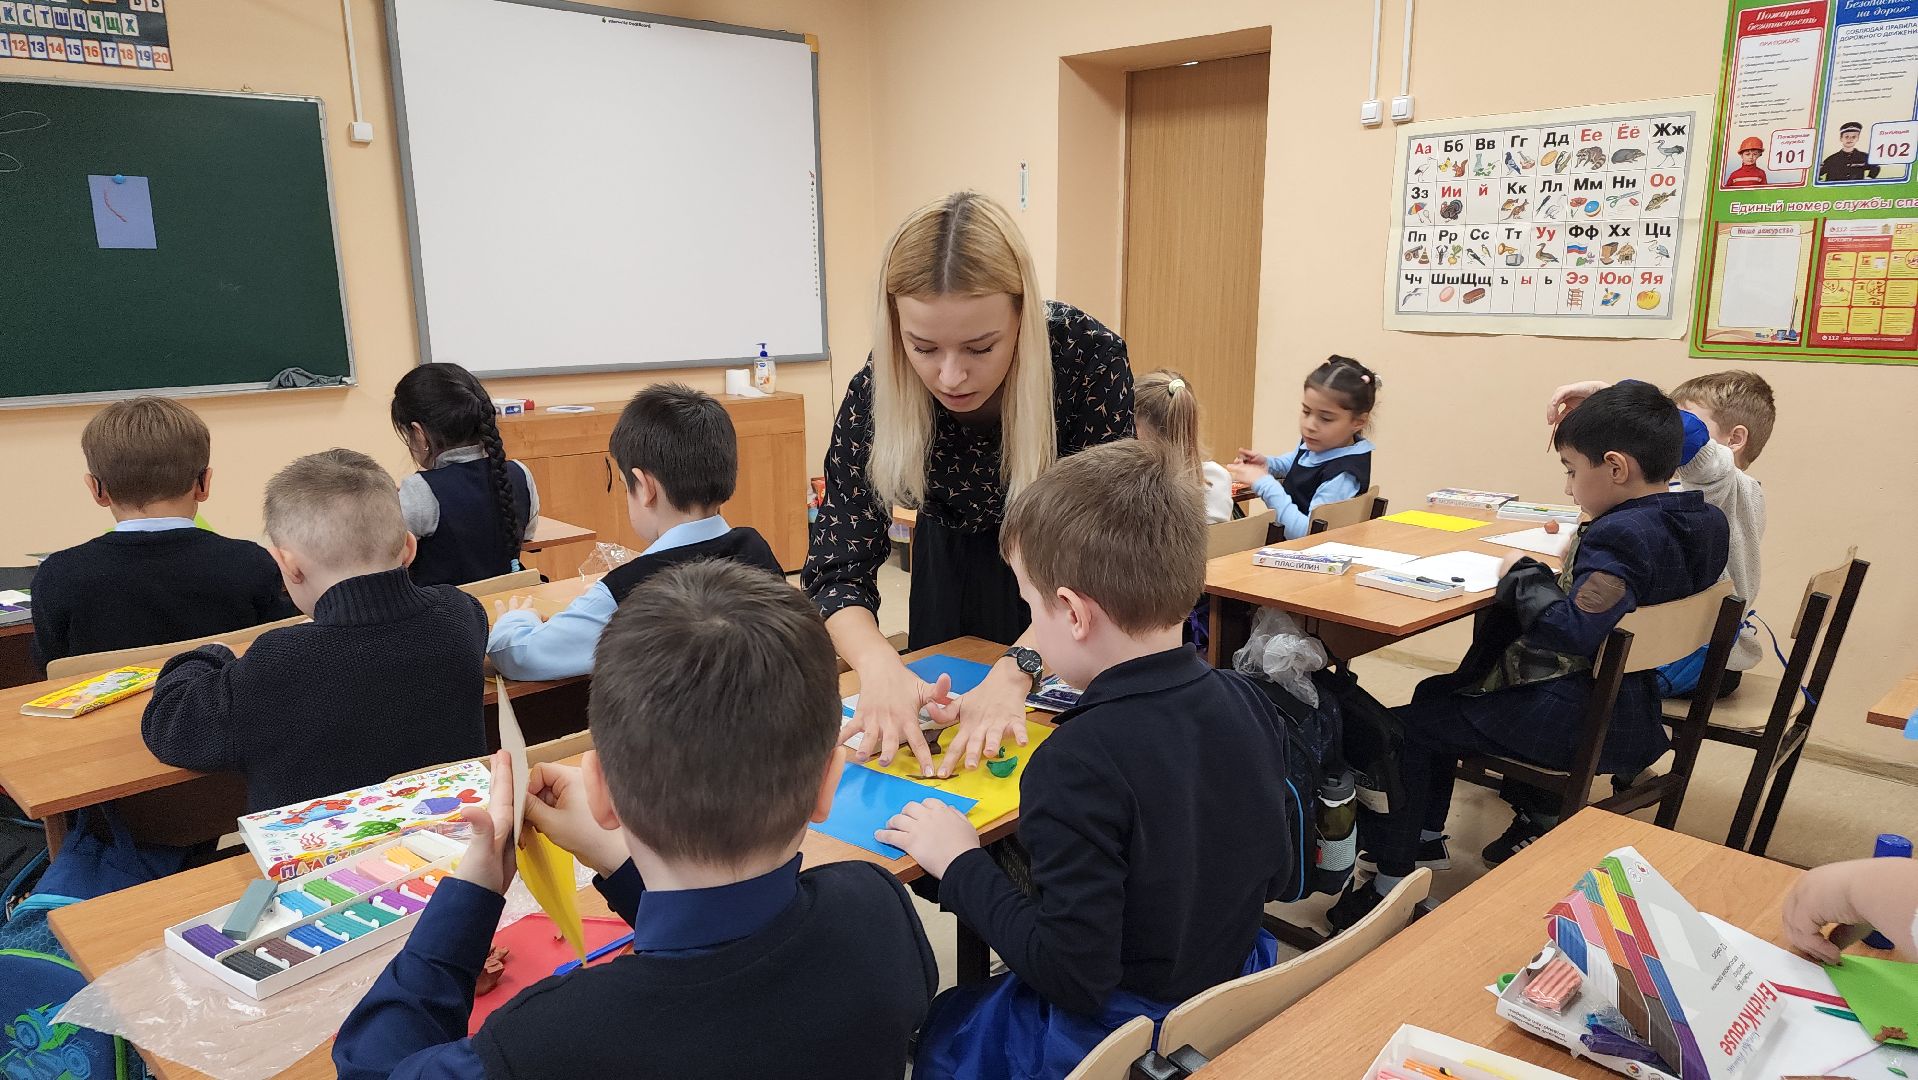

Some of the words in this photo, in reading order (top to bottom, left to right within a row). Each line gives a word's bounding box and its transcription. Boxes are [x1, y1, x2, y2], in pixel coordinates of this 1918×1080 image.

[1756, 8, 1810, 21] Пожарная
[1874, 6, 1910, 16] дороге
[4, 7, 15, 22] К
[23, 9, 32, 23] С
[40, 11, 49, 24] Т
[54, 12, 68, 26] Ш
[74, 13, 85, 30] Ц
[91, 15, 101, 29] Ч
[126, 19, 135, 32] Х
[1840, 32, 1882, 42] ДОРОЖНОГО
[1883, 29, 1918, 37] ДВИЖЕНИ
[1846, 26, 1884, 35] СОБЛЮДАЙ
[1885, 22, 1917, 30] ПРАВИЛА
[12, 40, 27, 51] 12
[30, 41, 45, 52] 13
[49, 43, 63, 54] 14
[67, 44, 80, 55] 15
[85, 46, 98, 57] 16
[103, 48, 116, 58] 17
[120, 49, 133, 60] 18
[138, 50, 150, 61] 19
[154, 52, 168, 63] 20
[1415, 143, 1431, 154] Аа
[1444, 139, 1463, 152] Бб
[1476, 138, 1495, 150] Вв
[1511, 135, 1528, 148] Гг
[1543, 132, 1569, 148] Дд
[1581, 129, 1602, 141] Ее
[1618, 124, 1640, 139] Ёё
[1652, 123, 1686, 137] Жж
[1776, 150, 1804, 163] 101
[1877, 143, 1910, 157] 102
[1411, 187, 1428, 199] Зз
[1442, 186, 1461, 198] Ии
[1479, 184, 1488, 196] й
[1507, 182, 1527, 194] Кк
[1540, 180, 1562, 193] Лл
[1574, 178, 1602, 191] Мм
[1613, 176, 1636, 189] Нн
[1650, 174, 1675, 187] Оо
[1731, 200, 1783, 214] Единый
[1787, 202, 1830, 213] номер
[1835, 197, 1892, 212] службы
[1408, 231, 1426, 242] Пп
[1439, 230, 1458, 244] Рр
[1470, 229, 1489, 240] Сс
[1505, 228, 1522, 239] Тт
[1536, 227, 1555, 241] Уу
[1569, 225, 1599, 240] Фф
[1608, 224, 1631, 237] Хх
[1646, 223, 1671, 238] Цц
[1405, 274, 1422, 284] Чч
[1431, 274, 1459, 284] Шш
[1460, 273, 1491, 287] Щщ
[1500, 276, 1508, 284] ъ
[1521, 276, 1531, 284] ы
[1545, 276, 1552, 284] ь
[1566, 272, 1588, 284] Ээ
[1599, 272, 1631, 284] Юю
[1641, 272, 1663, 284] Яя
[1274, 560, 1320, 571] ПЛАСТИЛИН
[1720, 982, 1777, 1056] ErichKrause
